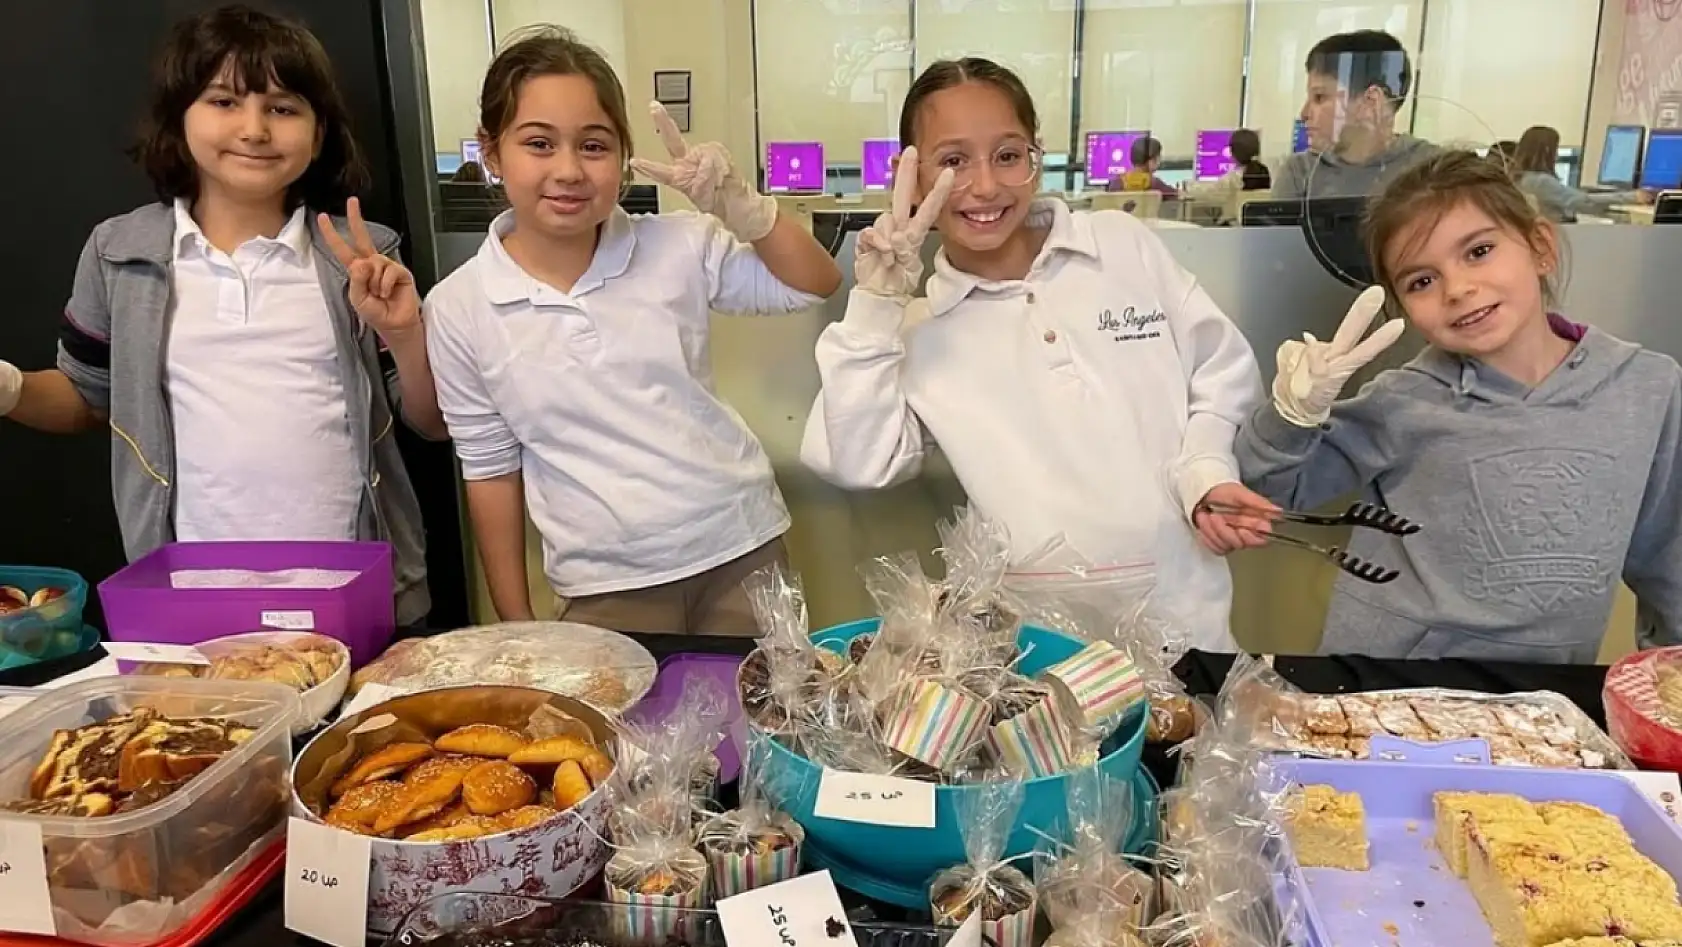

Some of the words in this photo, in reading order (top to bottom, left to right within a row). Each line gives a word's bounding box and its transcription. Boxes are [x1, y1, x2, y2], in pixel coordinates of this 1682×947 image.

[1098, 309, 1120, 330] Los
[1122, 306, 1167, 331] Angeles
[301, 869, 319, 883] 20
[767, 903, 787, 926] 25
